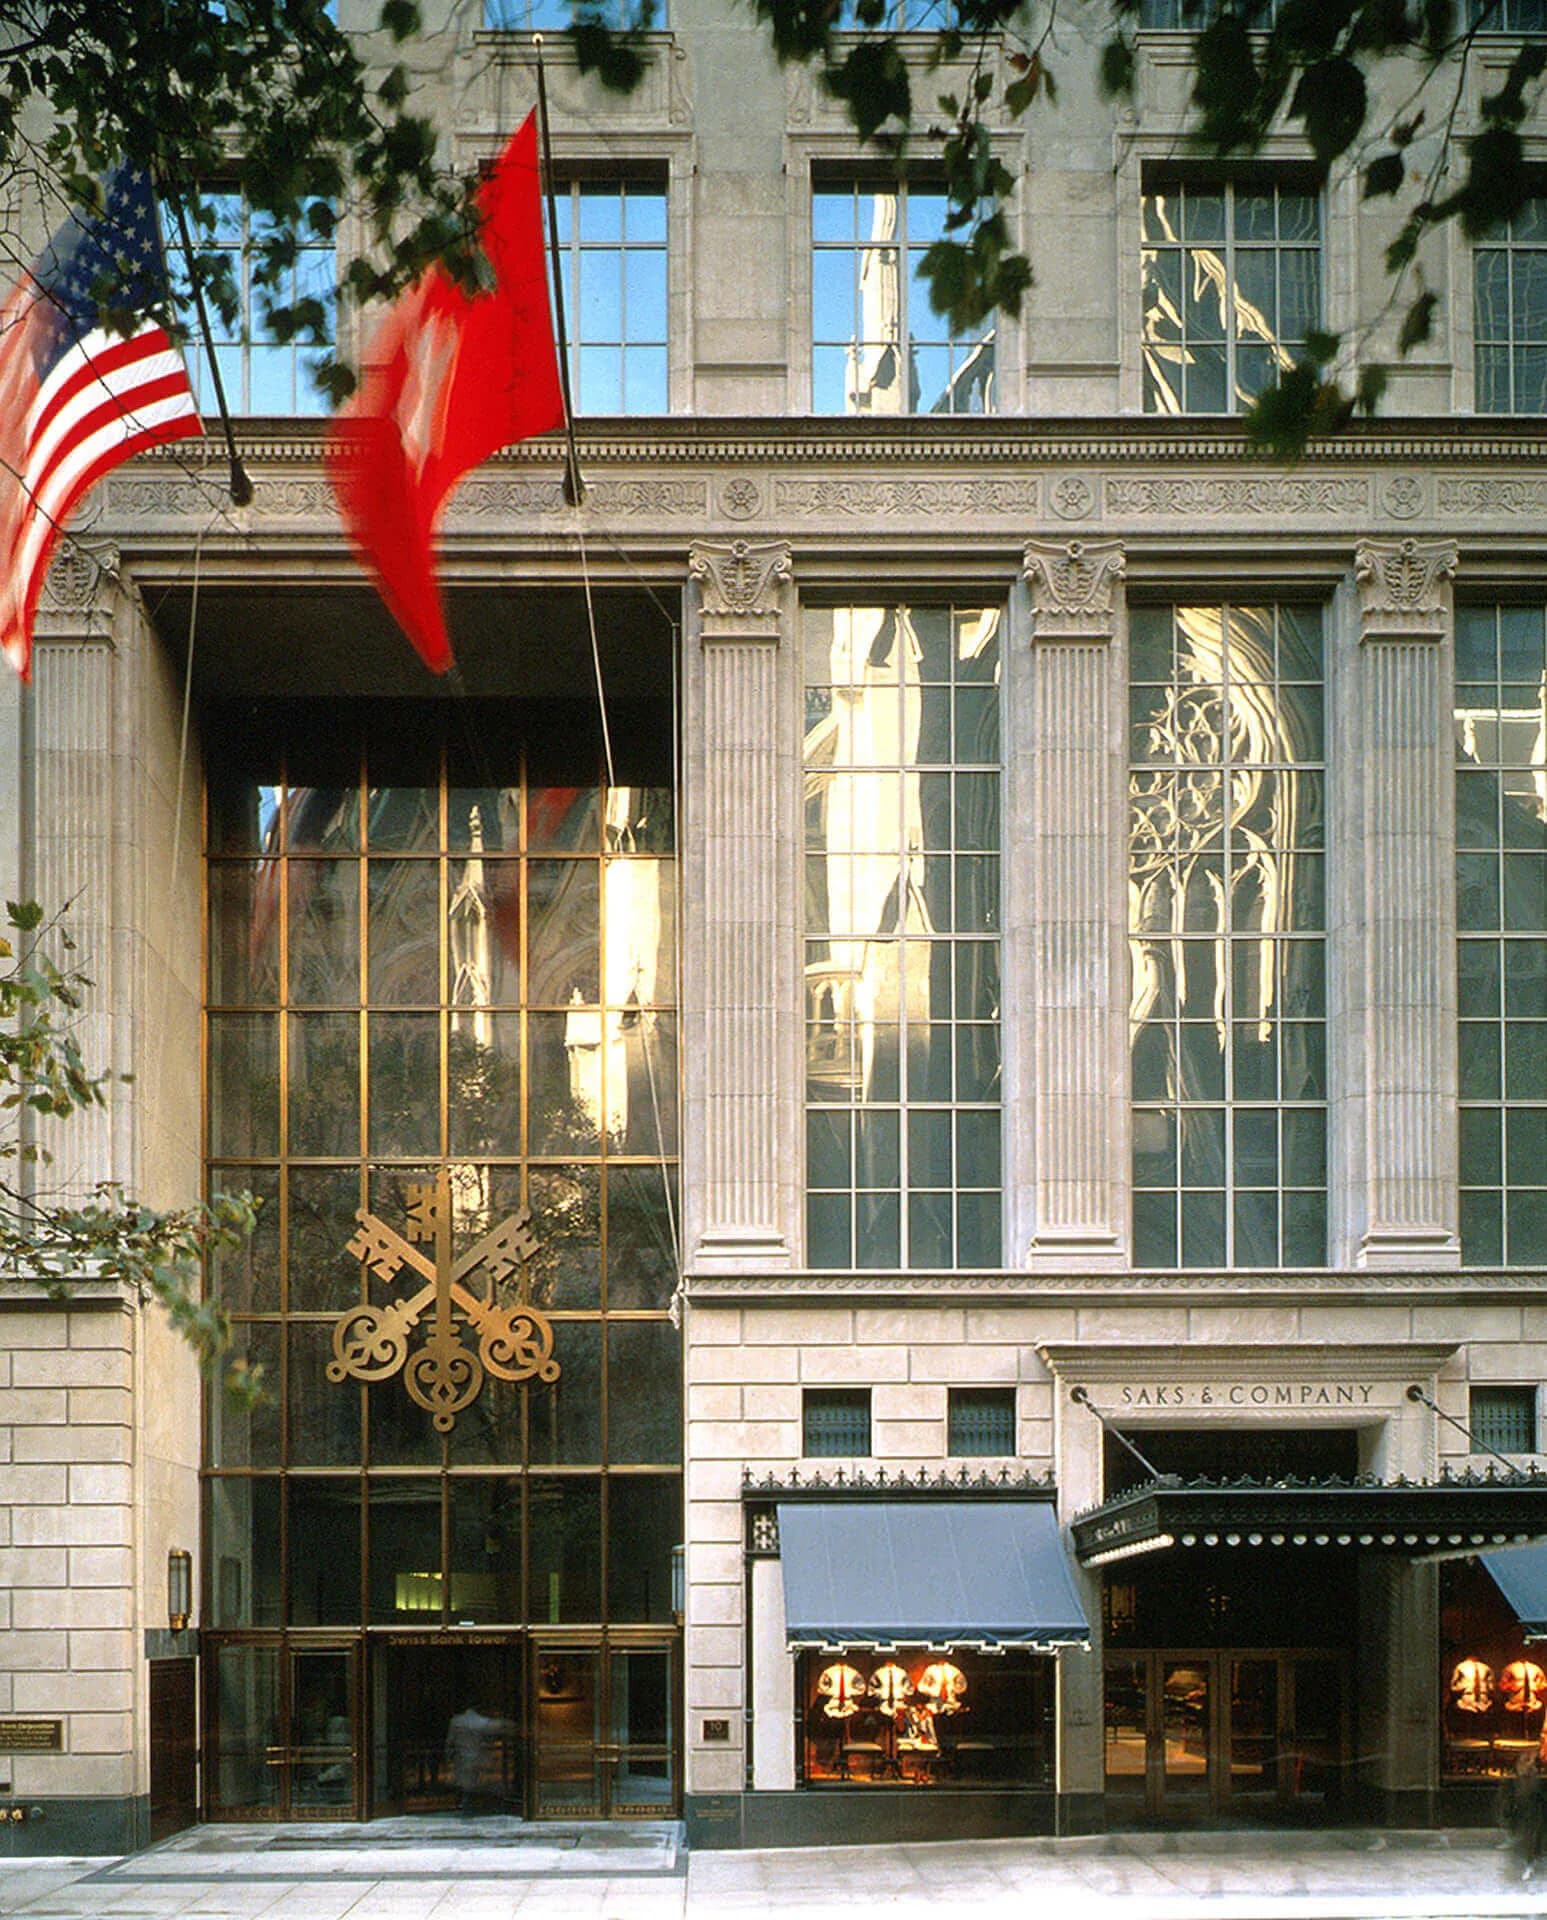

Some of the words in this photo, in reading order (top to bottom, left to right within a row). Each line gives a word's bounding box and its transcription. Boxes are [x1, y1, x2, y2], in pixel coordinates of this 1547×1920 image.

[1121, 1386, 1184, 1405] SAKS
[1201, 1386, 1214, 1404] &
[1228, 1385, 1373, 1405] COMPANY
[430, 1634, 465, 1645] Bank
